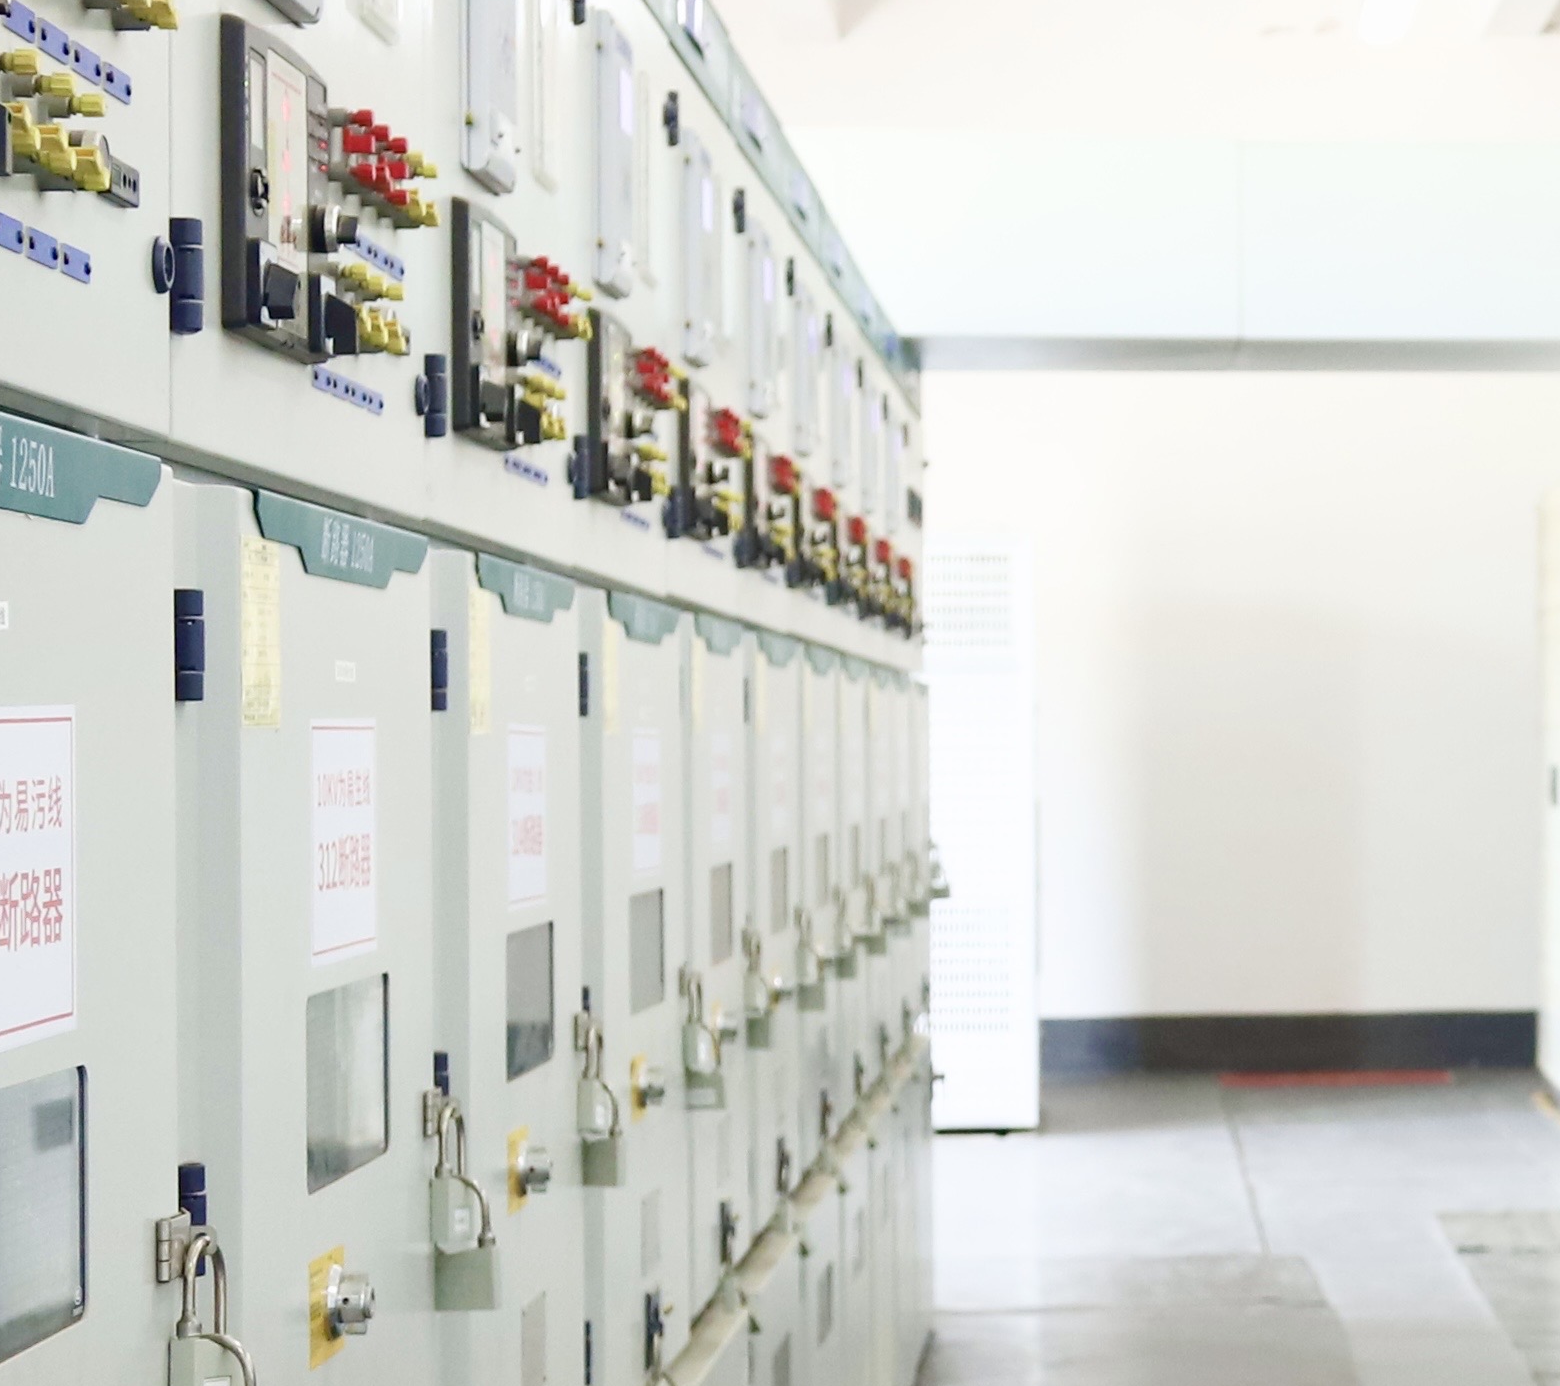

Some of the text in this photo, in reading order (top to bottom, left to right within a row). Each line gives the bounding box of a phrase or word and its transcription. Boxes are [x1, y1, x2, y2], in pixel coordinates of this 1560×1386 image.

[9, 435, 55, 499] 1250A
[317, 833, 371, 892] 312断路器
